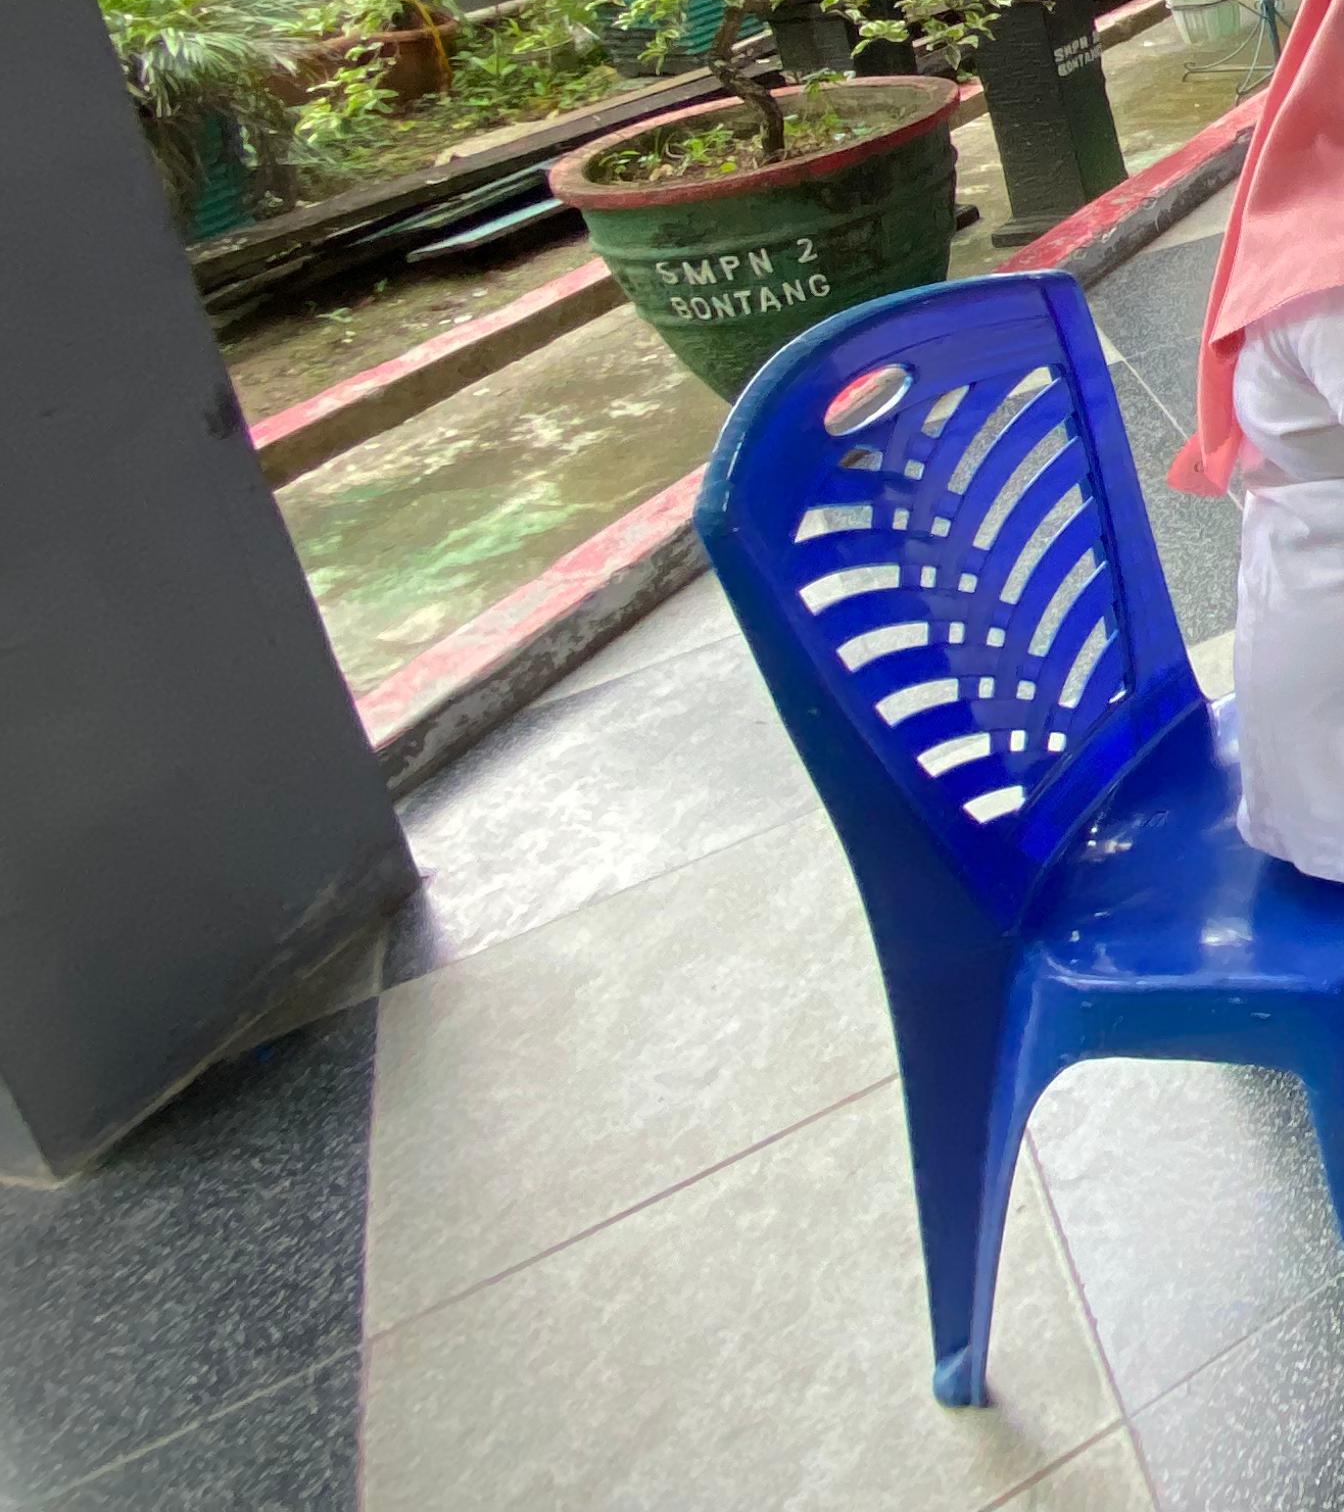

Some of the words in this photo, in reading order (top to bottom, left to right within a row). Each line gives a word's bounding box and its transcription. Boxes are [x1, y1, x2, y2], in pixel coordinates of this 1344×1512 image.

[655, 247, 774, 286] SMPN
[796, 238, 818, 264] 2
[669, 273, 832, 322] BONTANG
